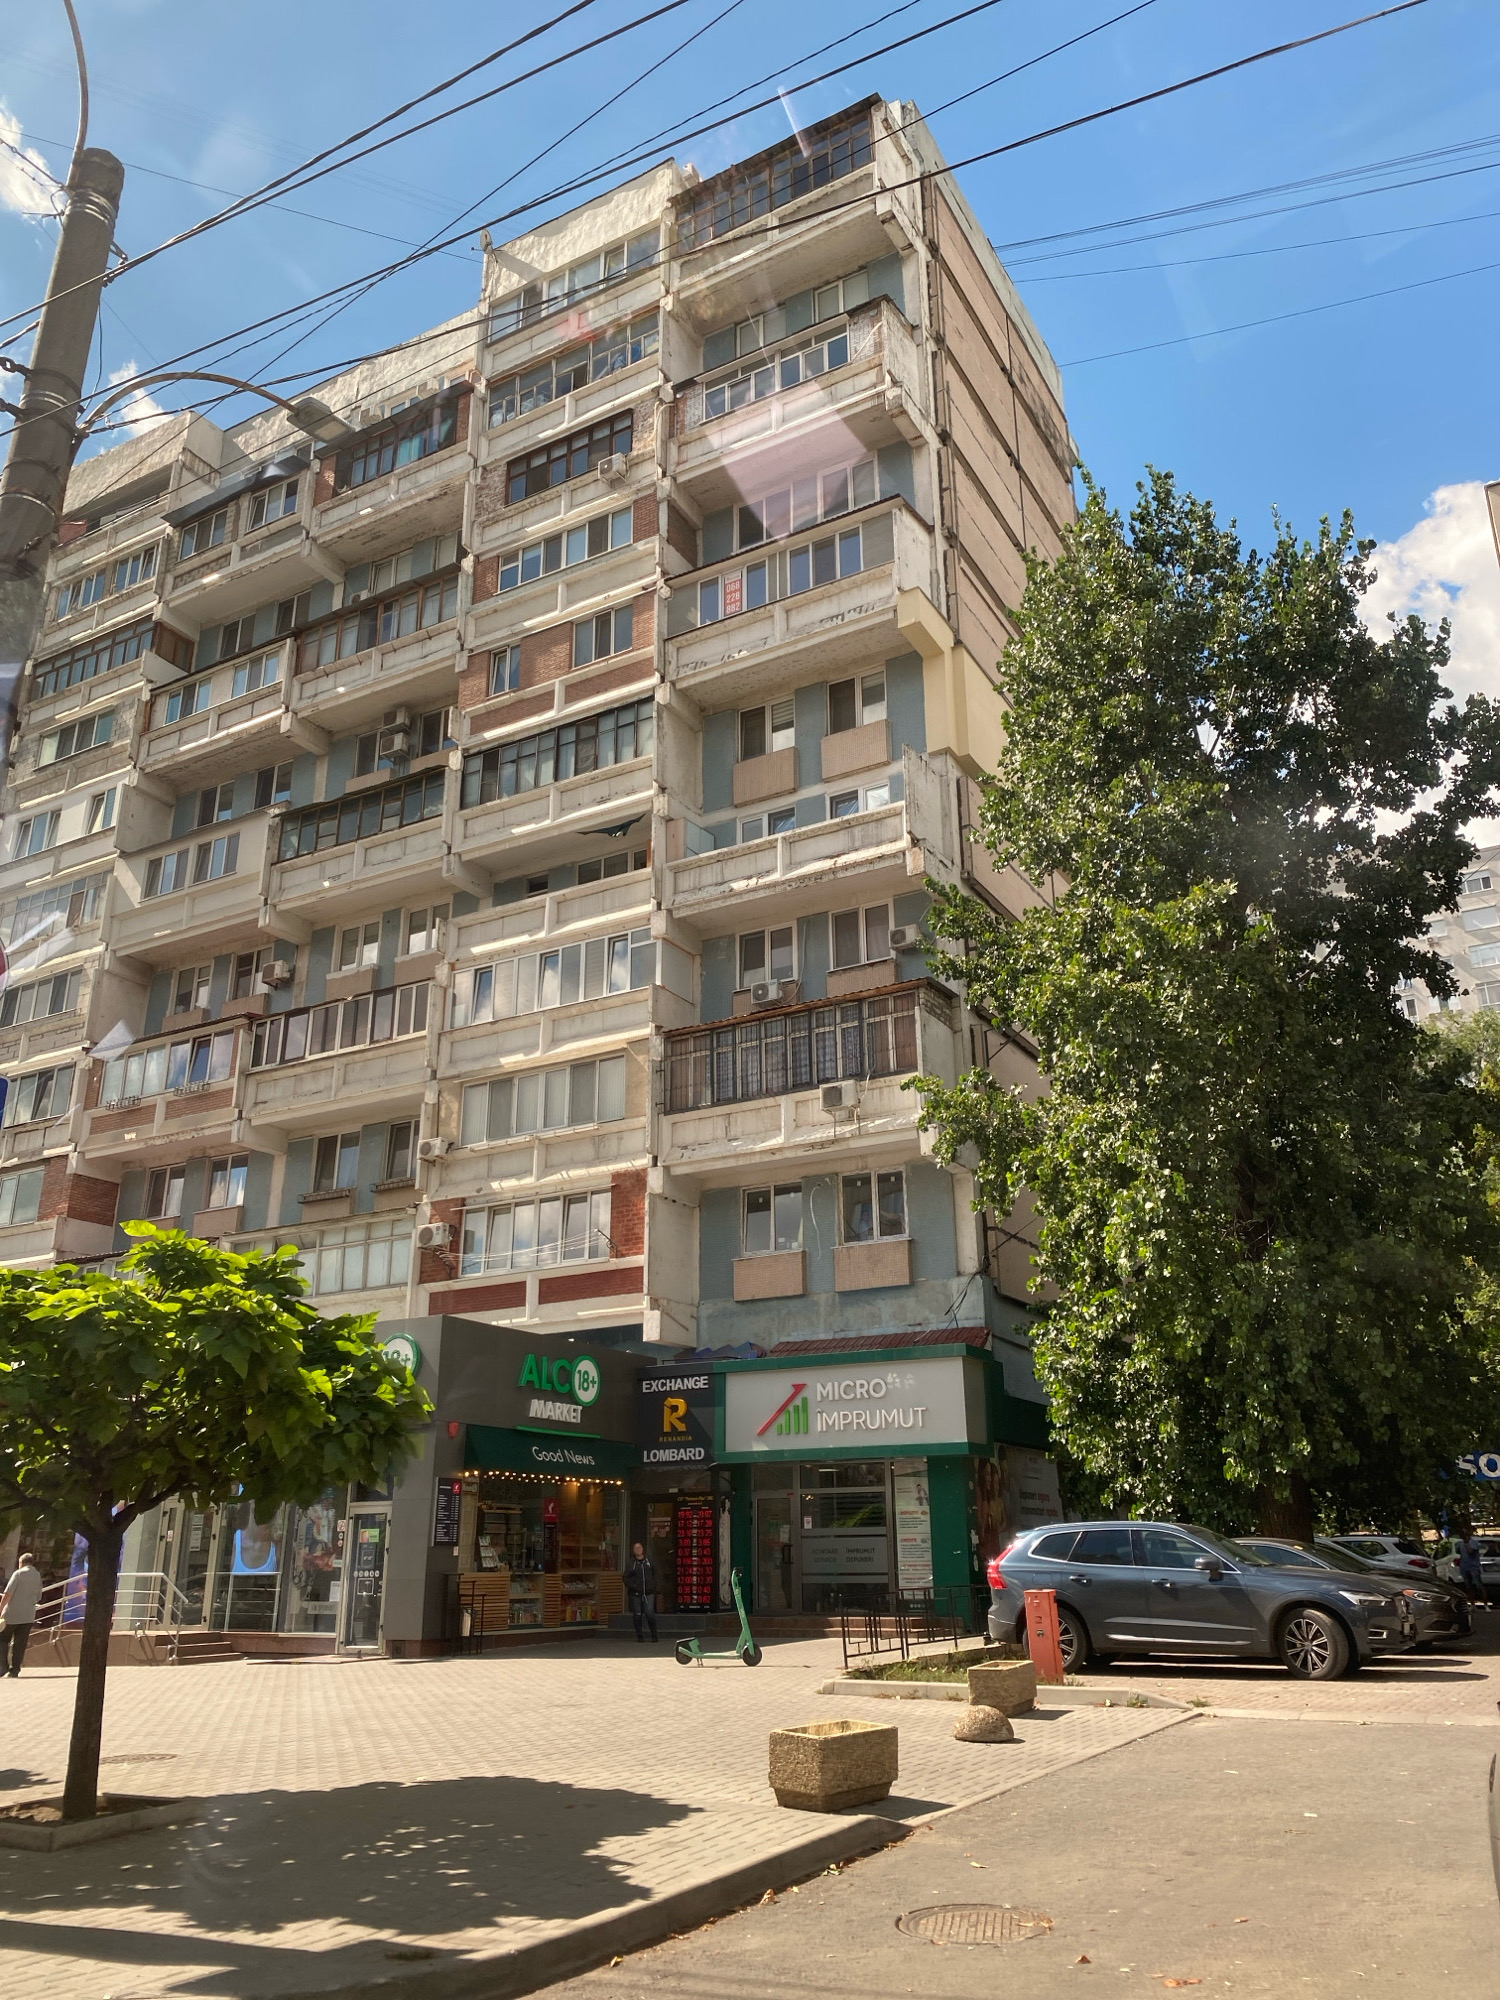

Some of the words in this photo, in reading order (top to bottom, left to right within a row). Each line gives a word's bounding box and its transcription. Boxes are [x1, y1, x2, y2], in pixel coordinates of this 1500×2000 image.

[577, 1369, 597, 1392] 18+
[642, 1375, 709, 1393] EXCHANGE
[816, 1378, 887, 1401] MICRO
[529, 1399, 582, 1424] MARKET
[816, 1406, 927, 1432] ÎMPRUMUT
[532, 1445, 564, 1462] Good
[564, 1449, 595, 1466] News
[643, 1447, 705, 1463] LOMBARD
